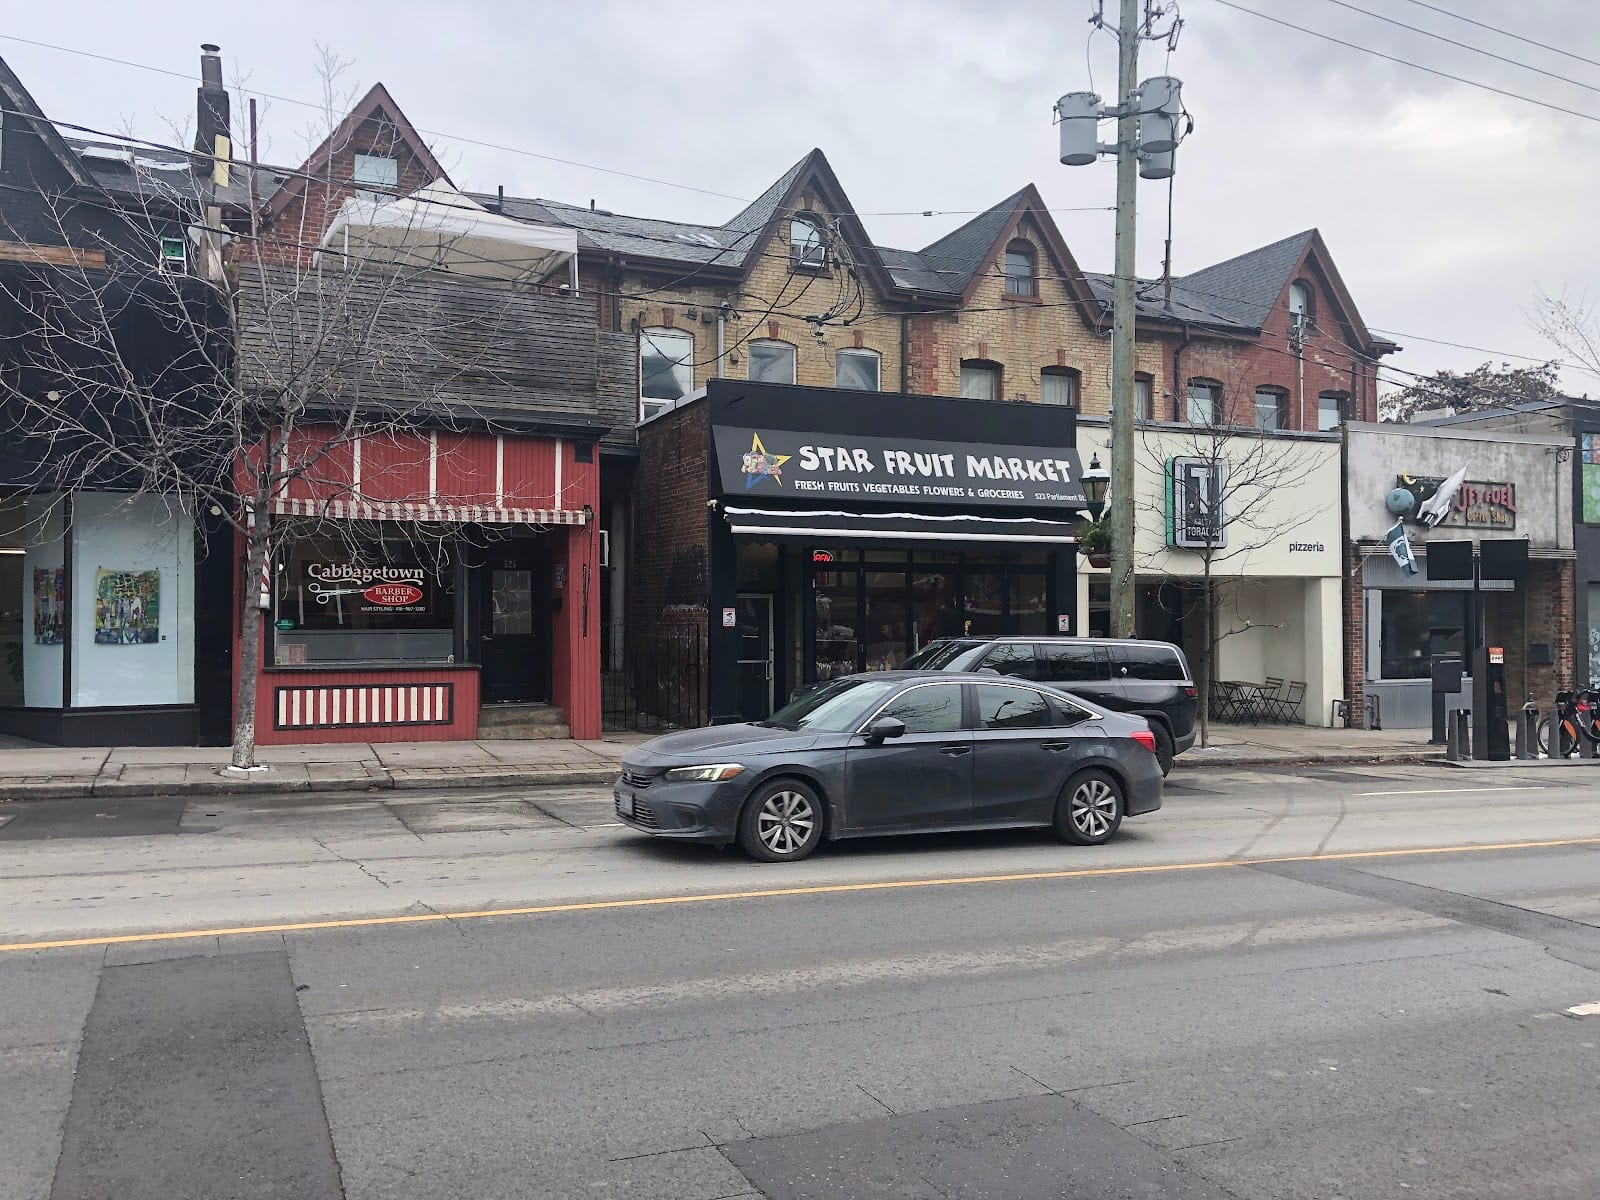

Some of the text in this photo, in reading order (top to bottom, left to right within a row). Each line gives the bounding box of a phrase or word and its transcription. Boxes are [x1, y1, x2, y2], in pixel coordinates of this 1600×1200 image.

[799, 445, 1070, 483] STAR FRUIT MARKET
[794, 480, 1024, 499] FRESH FRUITS VEGETABLES FLOWERS & GROCERIES
[1034, 492, 1046, 500] 523
[1046, 493, 1078, 501] Parliament
[1456, 481, 1517, 513] JET FUEL
[1492, 511, 1509, 524] Shop
[1289, 541, 1324, 553] pizzeria
[307, 563, 424, 585] Cabbagetown
[375, 587, 415, 596] BARBER
[382, 595, 408, 603] SHOP
